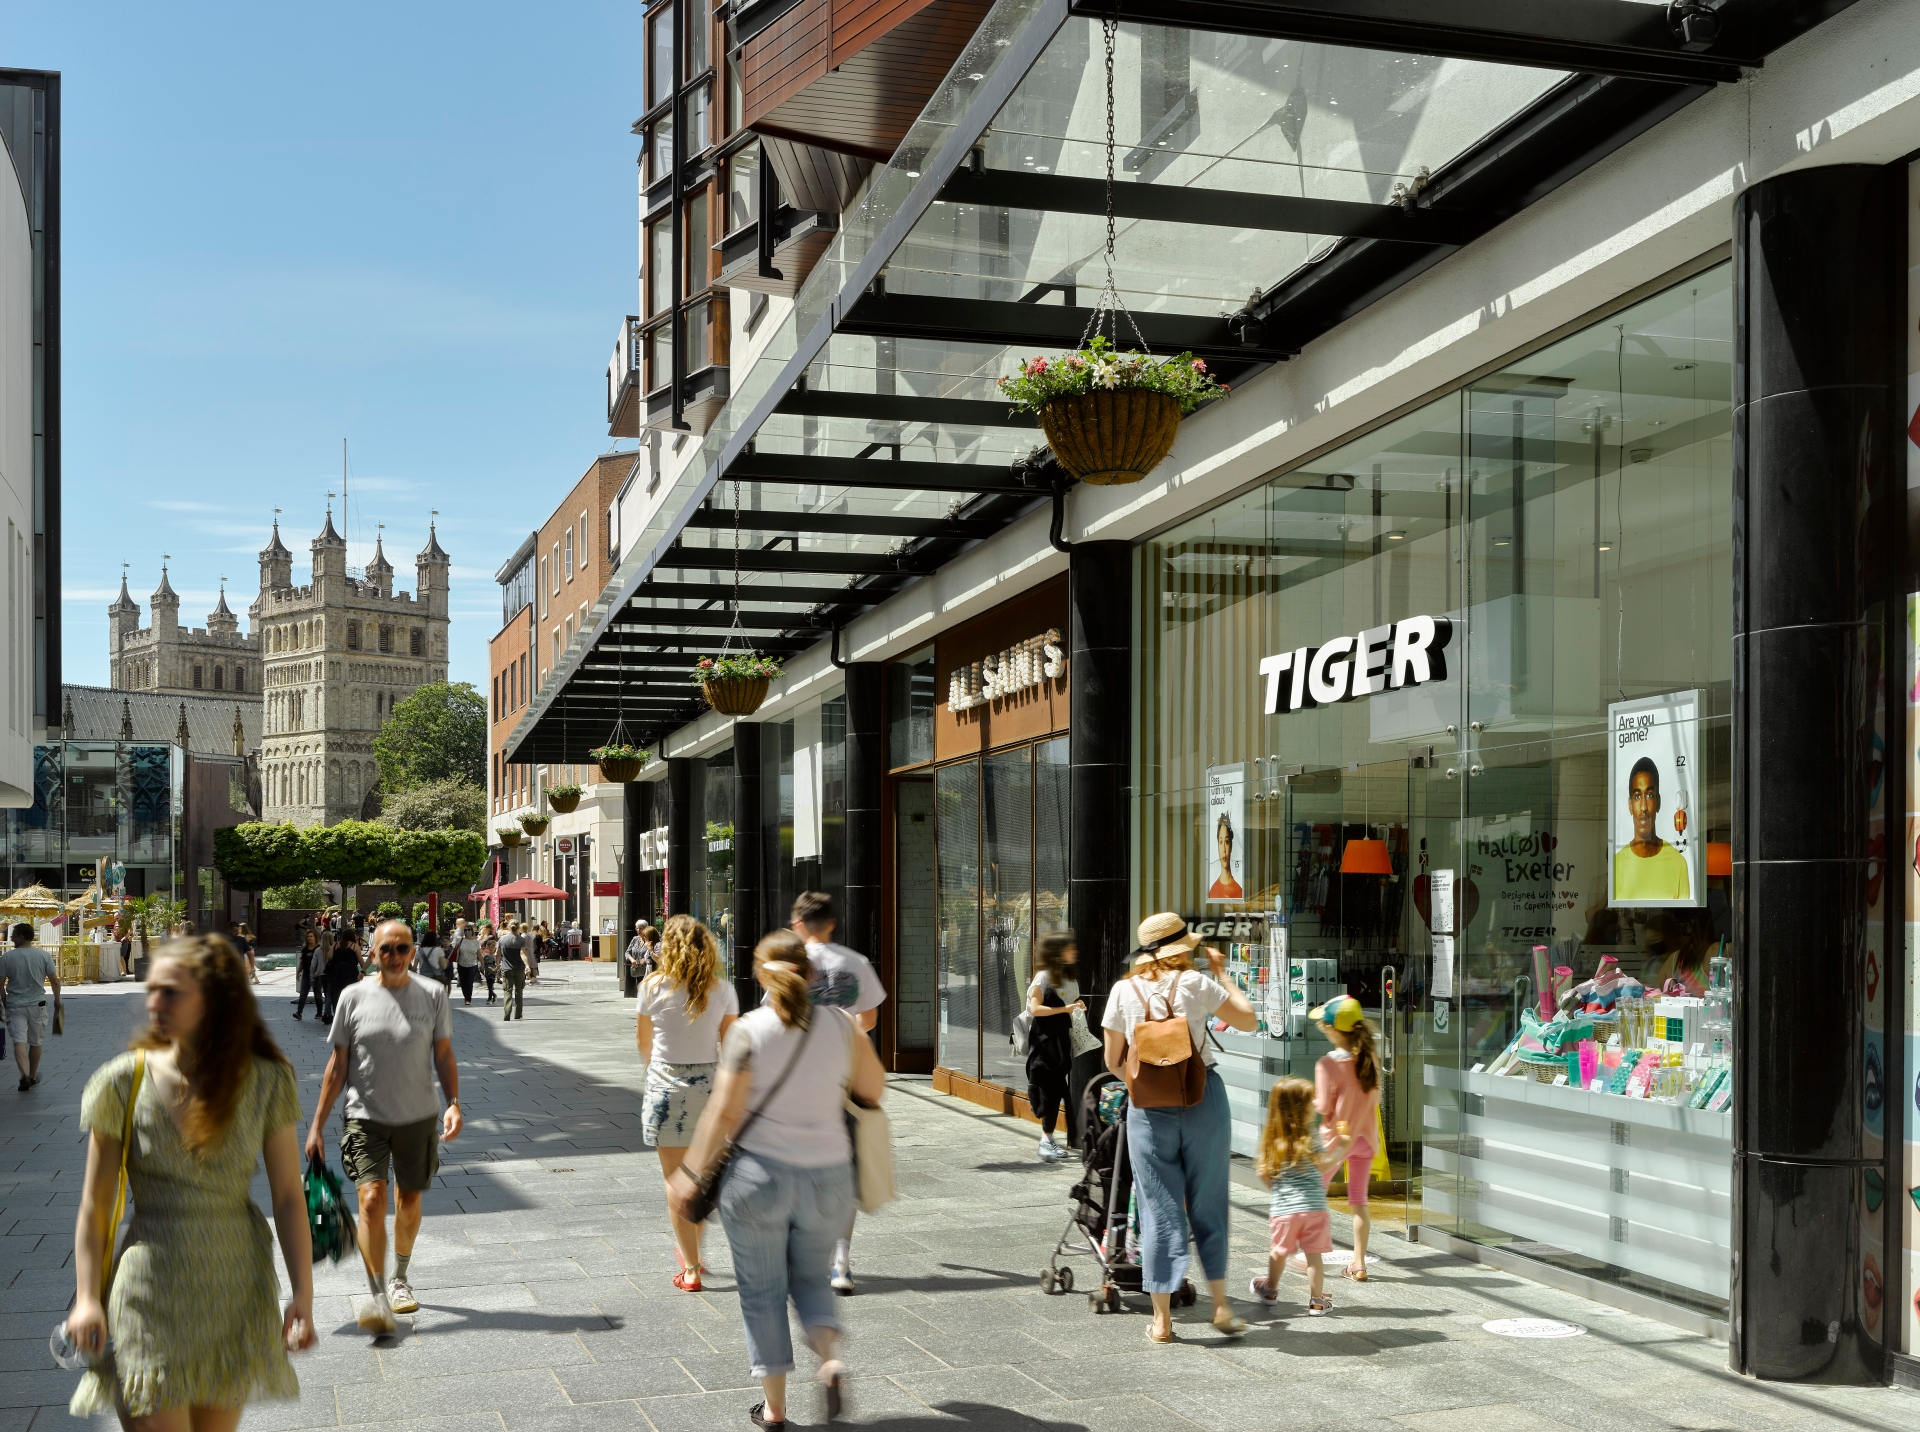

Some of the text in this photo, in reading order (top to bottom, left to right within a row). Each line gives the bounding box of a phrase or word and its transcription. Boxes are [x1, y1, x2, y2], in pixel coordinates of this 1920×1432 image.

[1259, 615, 1442, 715] TIGER
[1619, 713, 1655, 731] Are you
[1618, 728, 1649, 748] game?
[1676, 755, 1686, 767] £2
[1504, 855, 1576, 883] Exeter
[1501, 890, 1537, 902] Designed
[1513, 901, 1521, 911] in
[1186, 921, 1253, 937] IGER
[1501, 926, 1557, 938] TIGER
